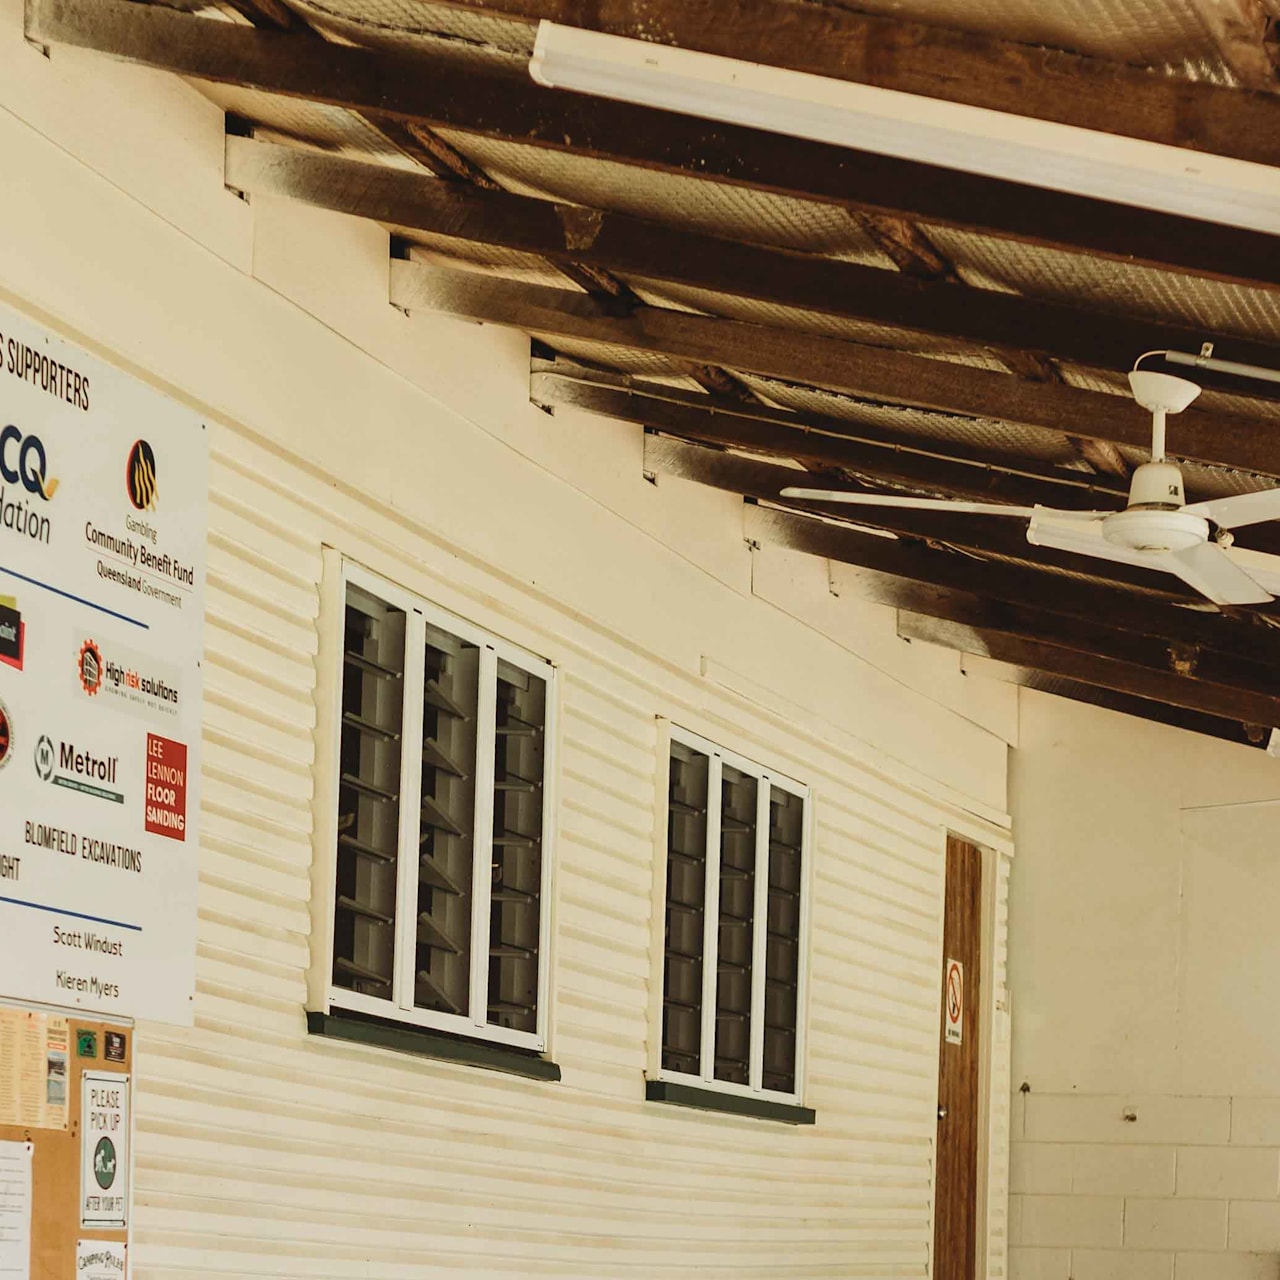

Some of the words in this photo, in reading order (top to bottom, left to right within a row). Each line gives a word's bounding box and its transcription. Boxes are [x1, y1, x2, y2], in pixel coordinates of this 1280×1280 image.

[7, 338, 90, 412] SUPPORTERS
[125, 514, 157, 545] Gambling
[85, 521, 139, 566] Community
[140, 545, 172, 577] Benefit
[173, 559, 194, 586] Fund
[96, 560, 141, 592] Queensland
[142, 580, 182, 609] Government
[105, 661, 125, 687] High
[125, 668, 140, 691] risk
[141, 676, 178, 704] solutions
[60, 741, 116, 784] Metroll
[148, 738, 163, 759] LEE
[147, 761, 184, 788] LENNON
[147, 783, 176, 807] FLOOR
[146, 805, 185, 831] SANDING
[24, 820, 77, 857] BLOMFIELD
[81, 836, 142, 874] EXCAVATIONS
[53, 926, 82, 950] Scott
[84, 930, 123, 957] Windust
[56, 970, 88, 993] Kieren
[91, 976, 120, 999] Myers
[90, 1089, 120, 1109] PLEASE
[90, 1112, 109, 1131] PICK
[110, 1113, 121, 1131] UP
